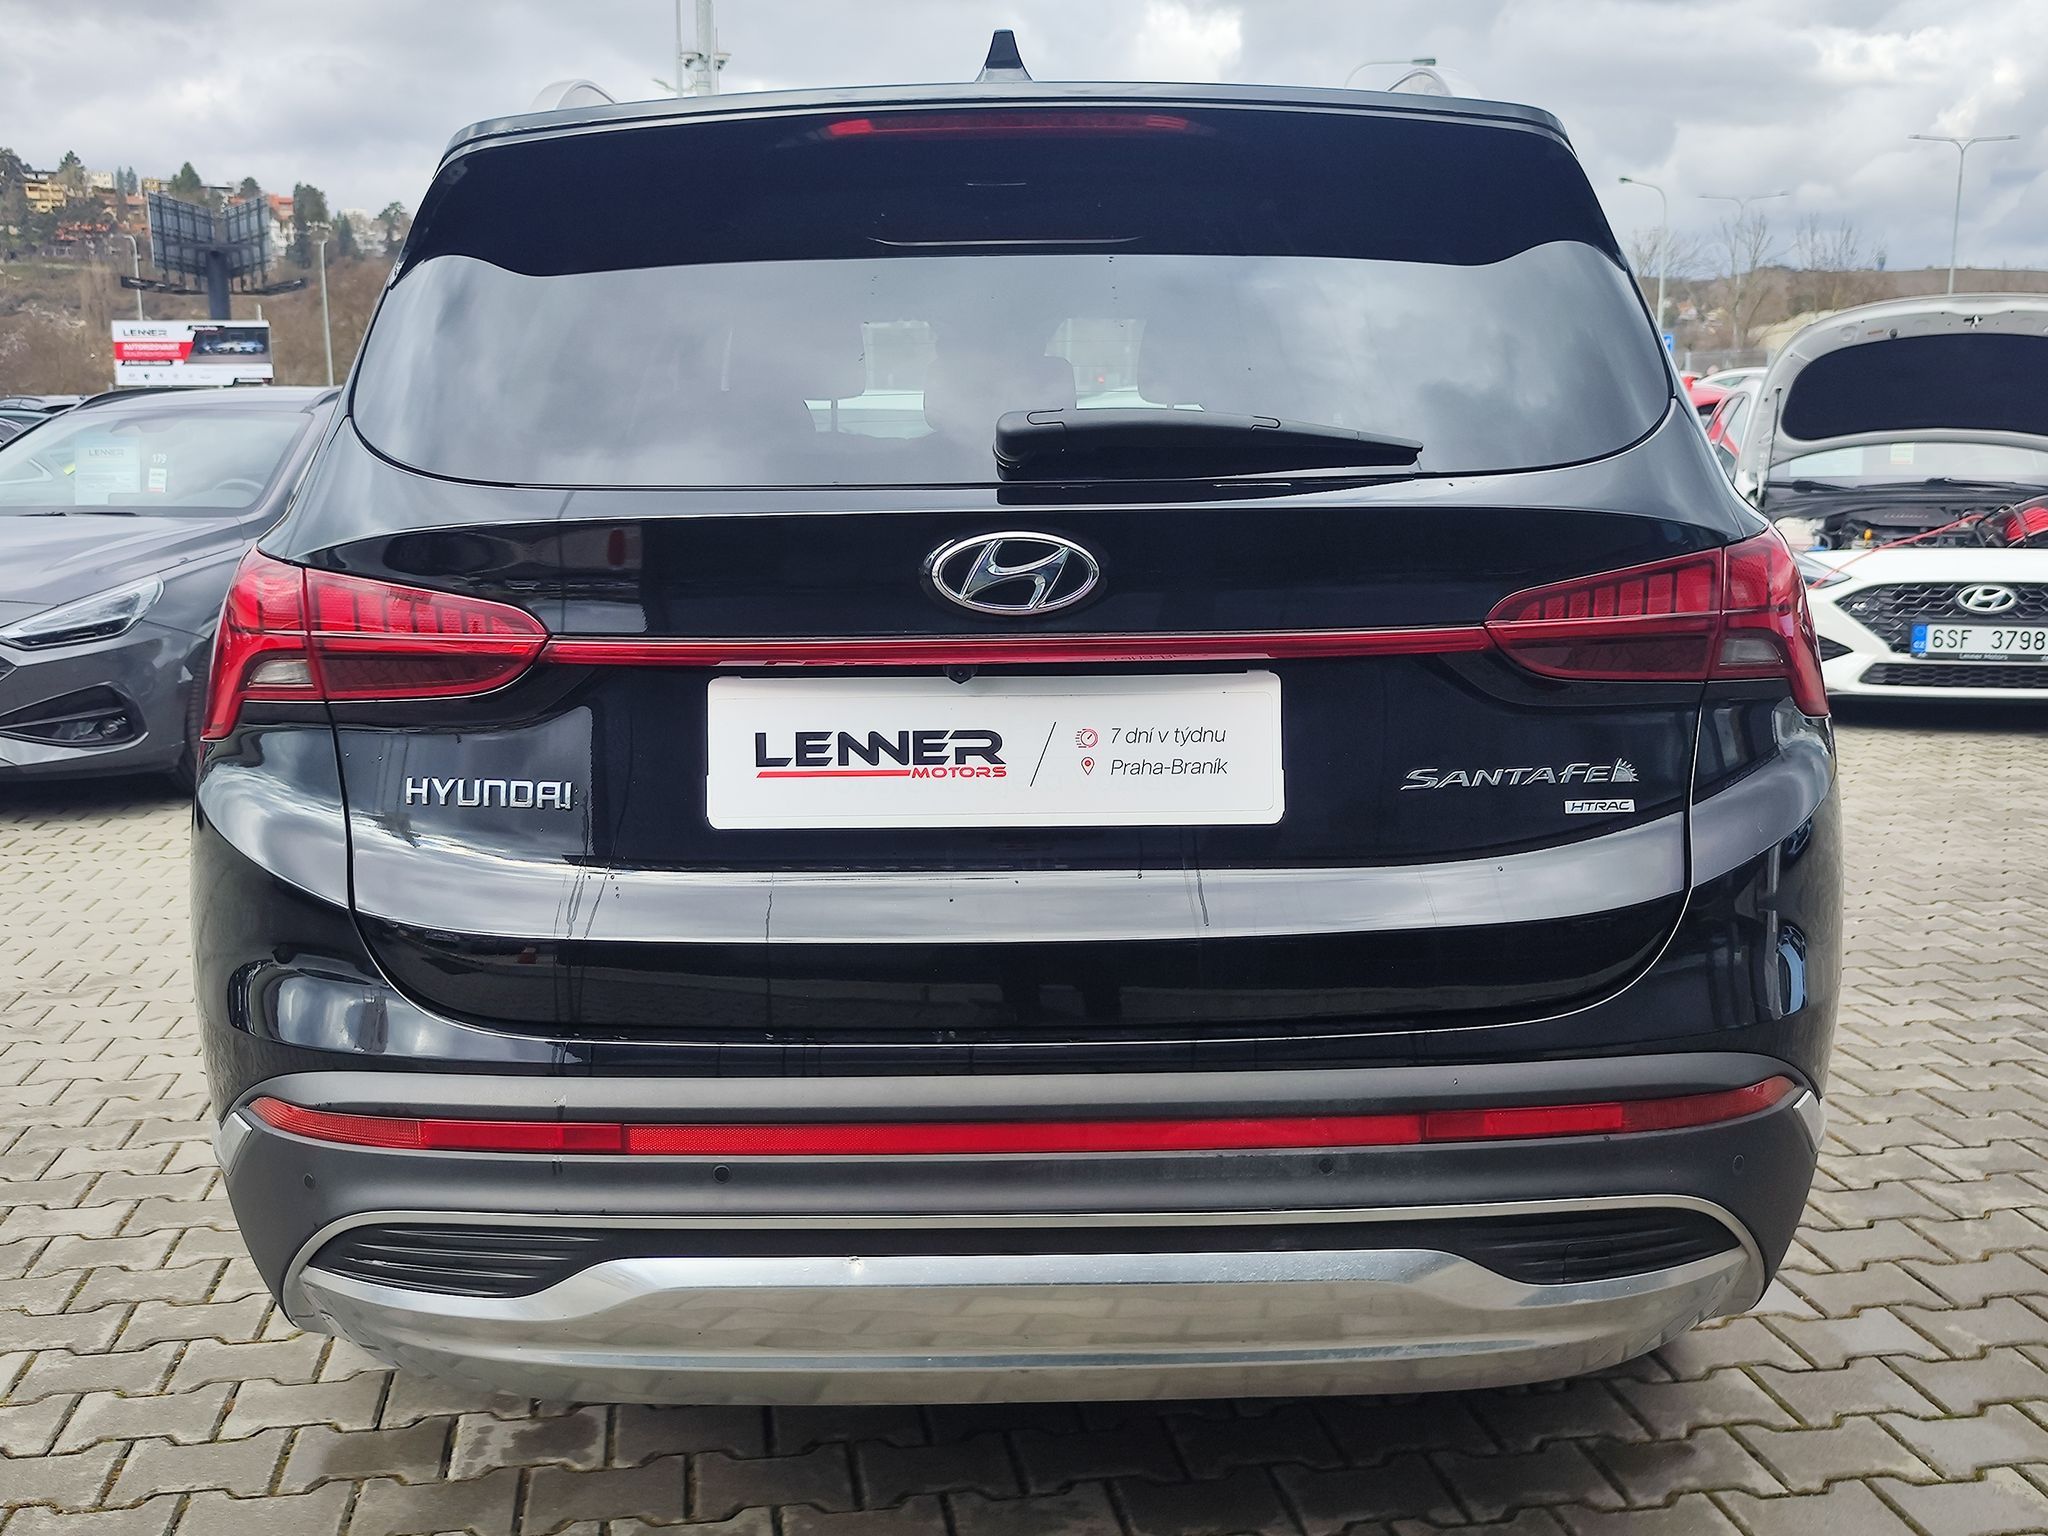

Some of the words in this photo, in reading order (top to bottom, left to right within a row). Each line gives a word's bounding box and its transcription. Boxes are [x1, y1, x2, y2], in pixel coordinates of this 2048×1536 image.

[1932, 629, 1973, 649] 6SF
[1991, 630, 2046, 651] 3798
[1111, 727, 1121, 744] 7
[1125, 727, 1155, 744] dní
[1158, 730, 1169, 743] v
[1173, 726, 1226, 747] týdnu
[755, 730, 1007, 767] LENNER
[911, 766, 1007, 779] MOTORS
[1110, 757, 1228, 775] Praha-Braník
[405, 776, 573, 810] HYUNDAI
[1571, 800, 1631, 812] HTRAC
